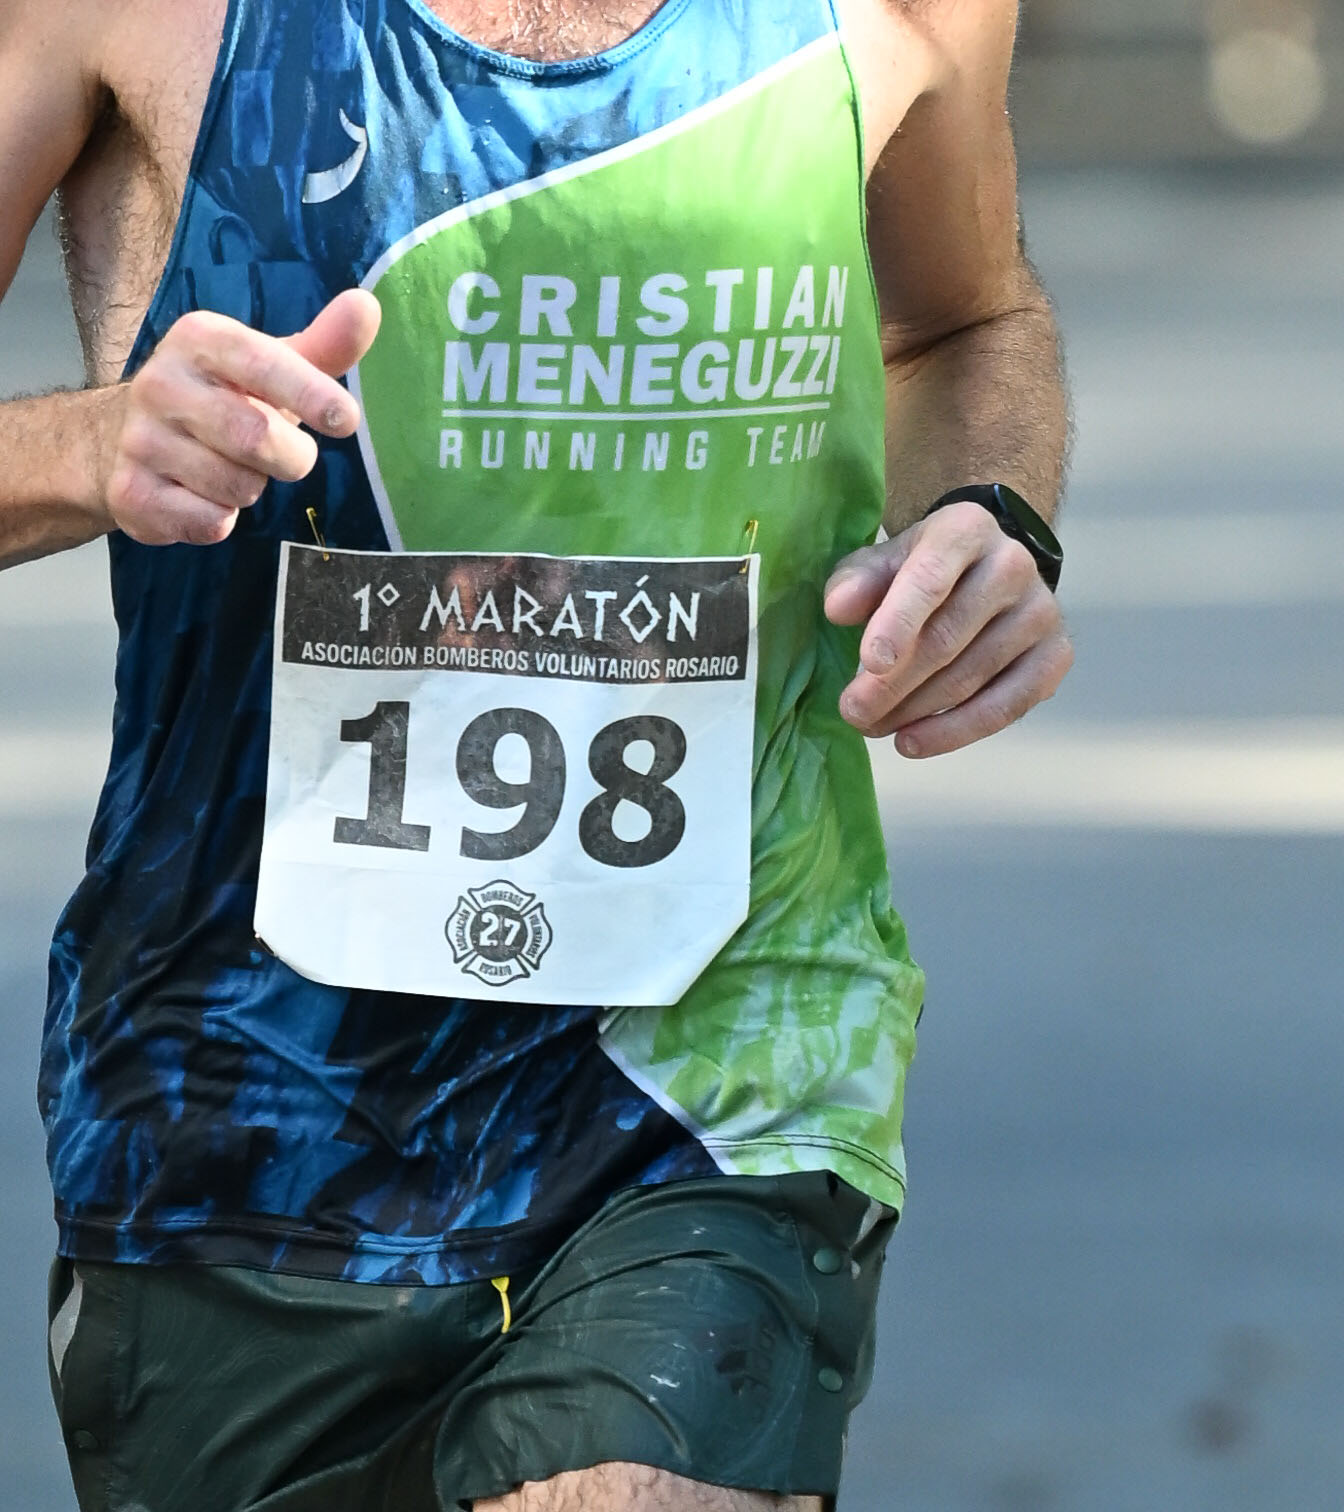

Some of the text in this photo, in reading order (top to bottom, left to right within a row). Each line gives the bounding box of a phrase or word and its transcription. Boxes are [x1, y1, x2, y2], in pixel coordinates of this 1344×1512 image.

[447, 265, 848, 337] CRISTIAN
[443, 335, 840, 405] MENEGUZZI
[439, 421, 826, 472] RUNNING TEAM
[418, 574, 701, 643] MARATÓN
[424, 646, 530, 672] BOMBEROS
[535, 652, 661, 679] VOLUNTARIOS
[665, 655, 739, 677] ROSARIO
[333, 700, 686, 868] 198
[478, 911, 521, 947] 27
